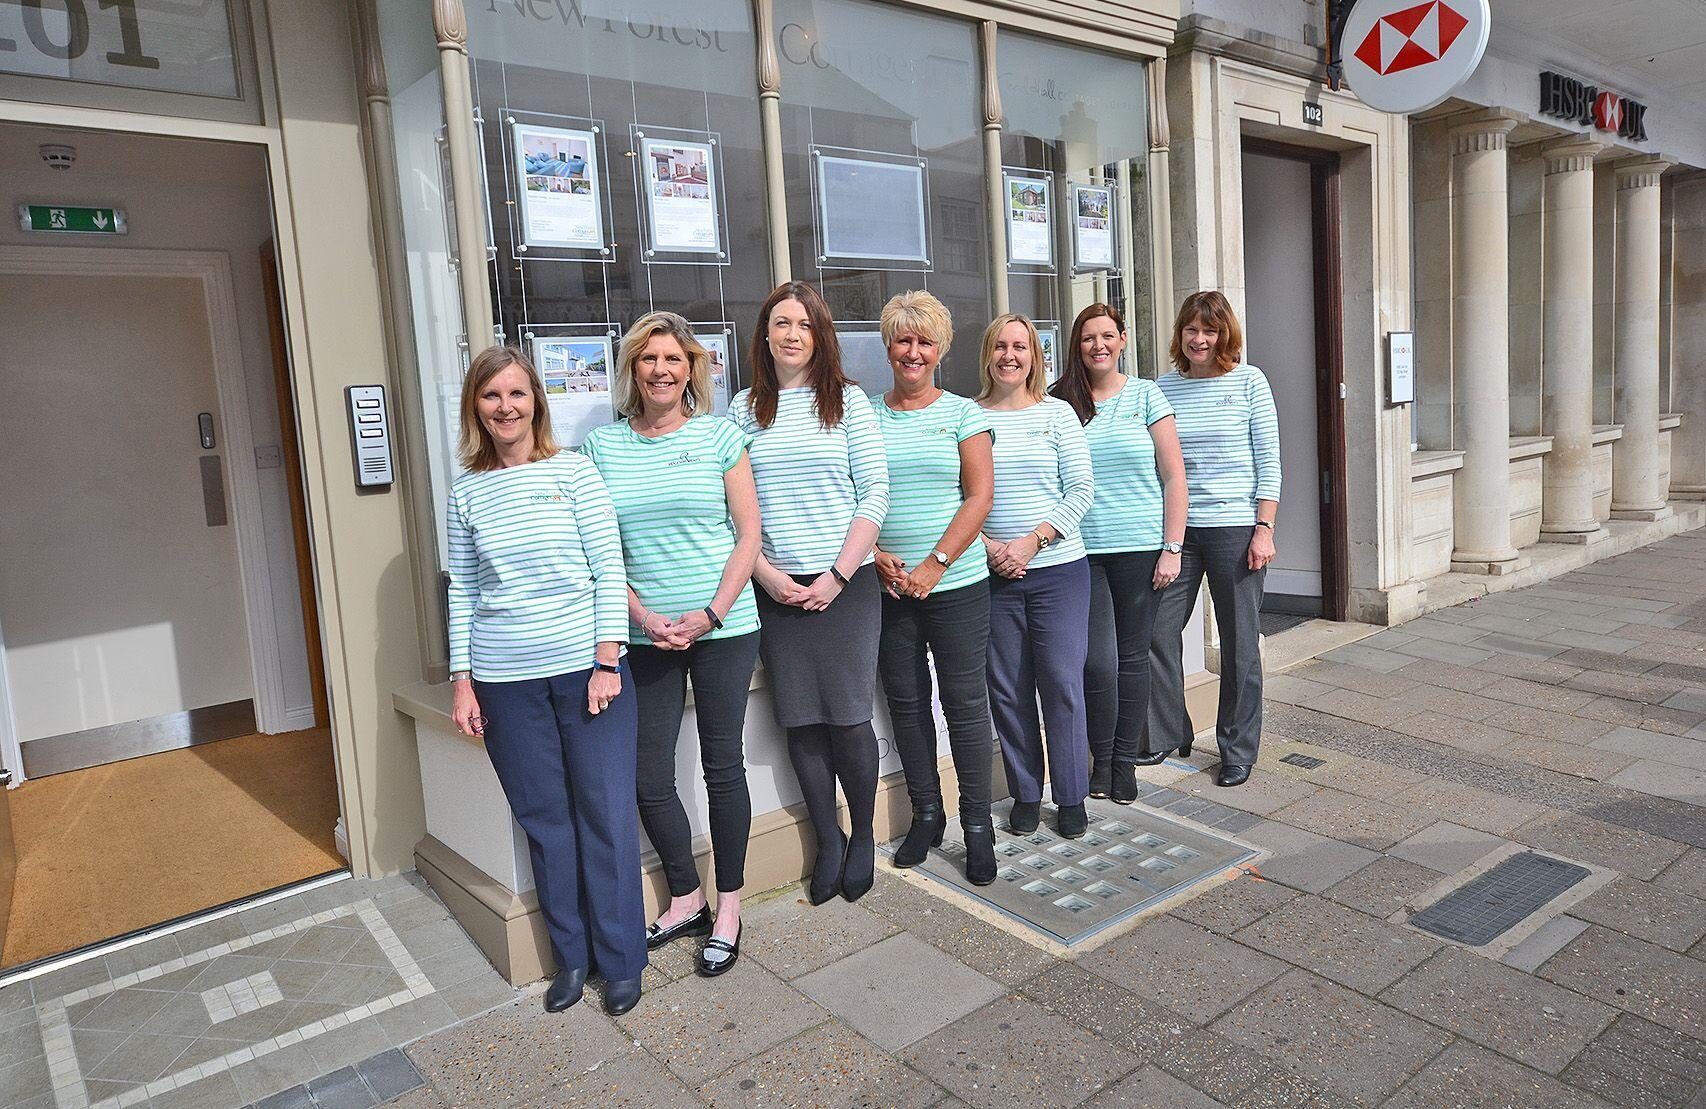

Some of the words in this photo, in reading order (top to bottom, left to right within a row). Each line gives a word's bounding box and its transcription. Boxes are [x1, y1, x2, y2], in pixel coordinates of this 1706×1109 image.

[0, 0, 160, 70] 01
[1304, 105, 1322, 122] 102
[1539, 70, 1600, 126] HSBC
